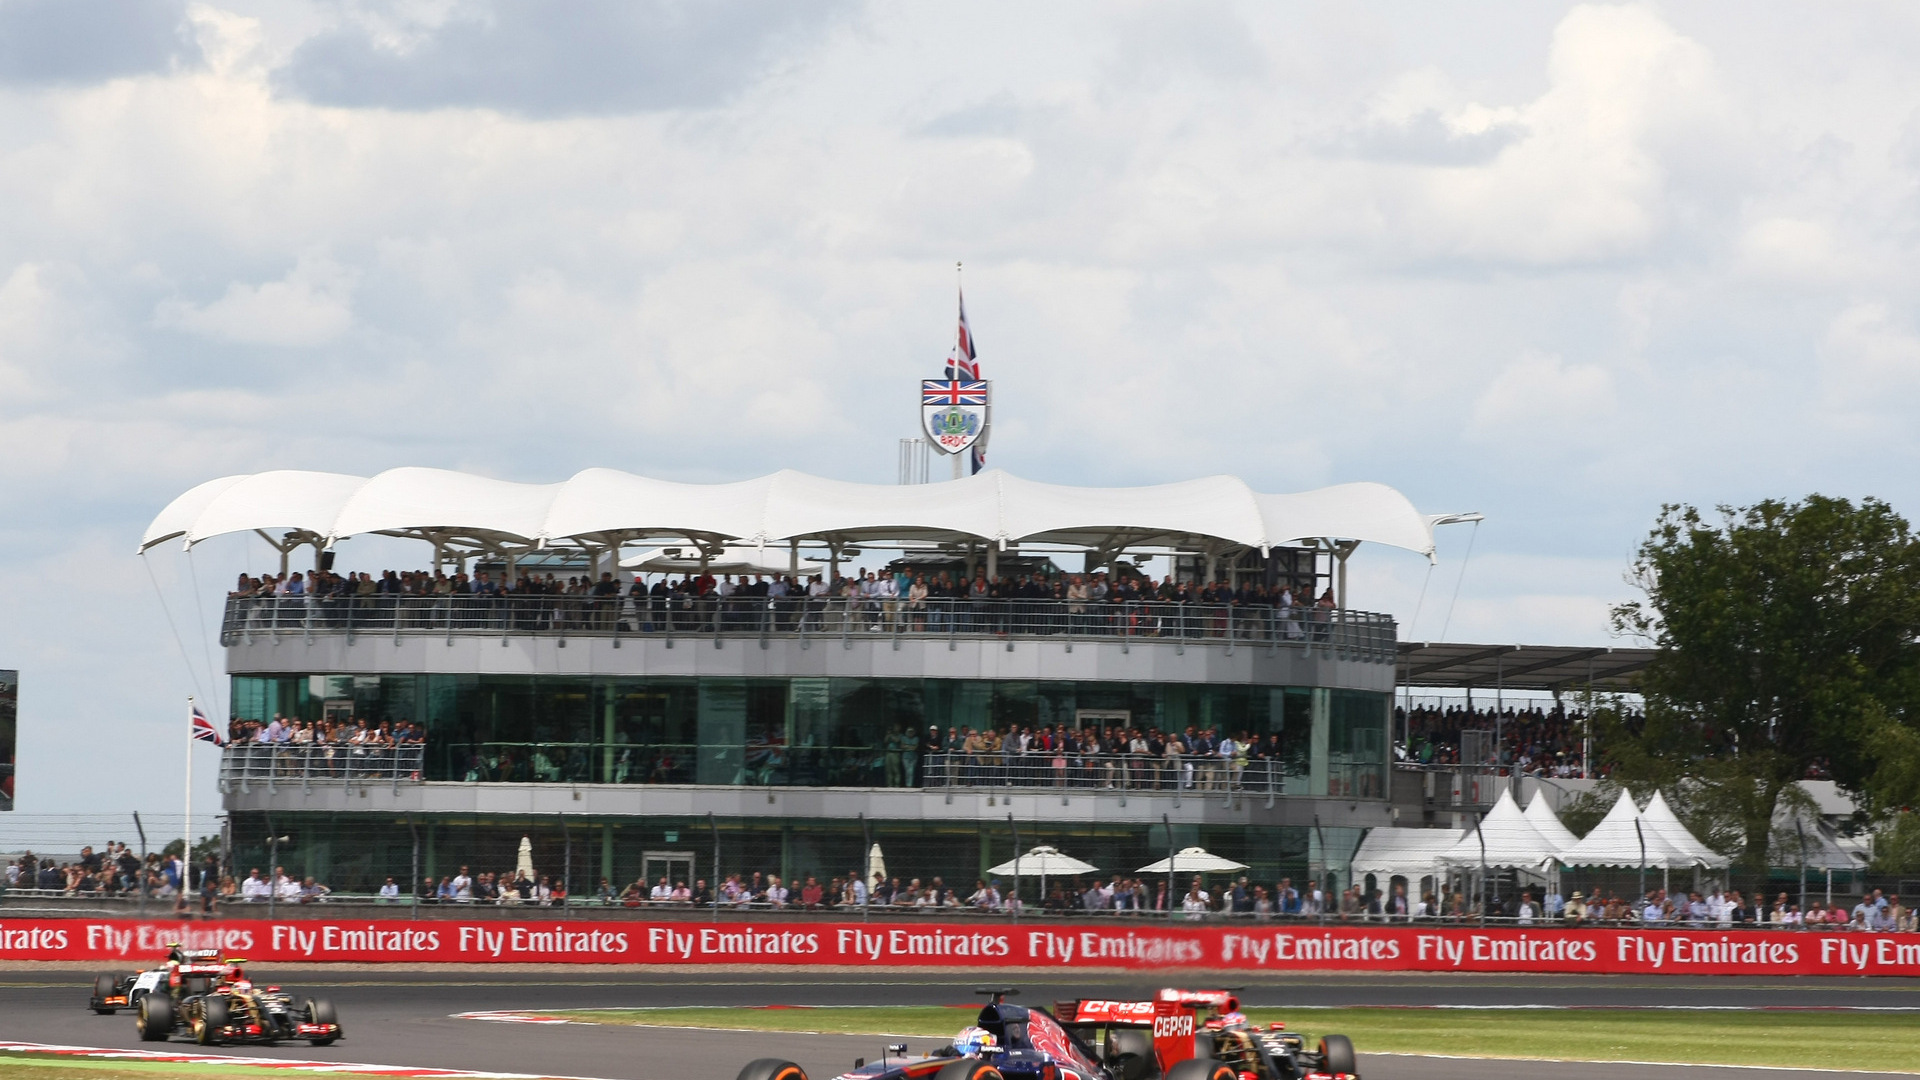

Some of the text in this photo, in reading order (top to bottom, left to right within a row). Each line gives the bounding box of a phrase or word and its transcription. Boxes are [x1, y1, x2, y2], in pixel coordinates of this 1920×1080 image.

[940, 435, 967, 447] BRDC
[87, 924, 254, 956] Fly Emirates
[271, 925, 440, 955] Fly Emirates
[459, 926, 631, 956] Fly Emirates
[648, 927, 819, 958] Fly Emirates
[837, 929, 1009, 960] Fly Emirates
[1028, 931, 1203, 962] Fly Emirates
[1222, 933, 1400, 964] Fly Emirates
[1417, 934, 1597, 965] Fly Emirates
[1616, 935, 1799, 969] Fly Emirates
[1820, 938, 1920, 970] Fly Em
[1084, 1000, 1154, 1014] CEPS
[1154, 1015, 1193, 1038] CEPSA
